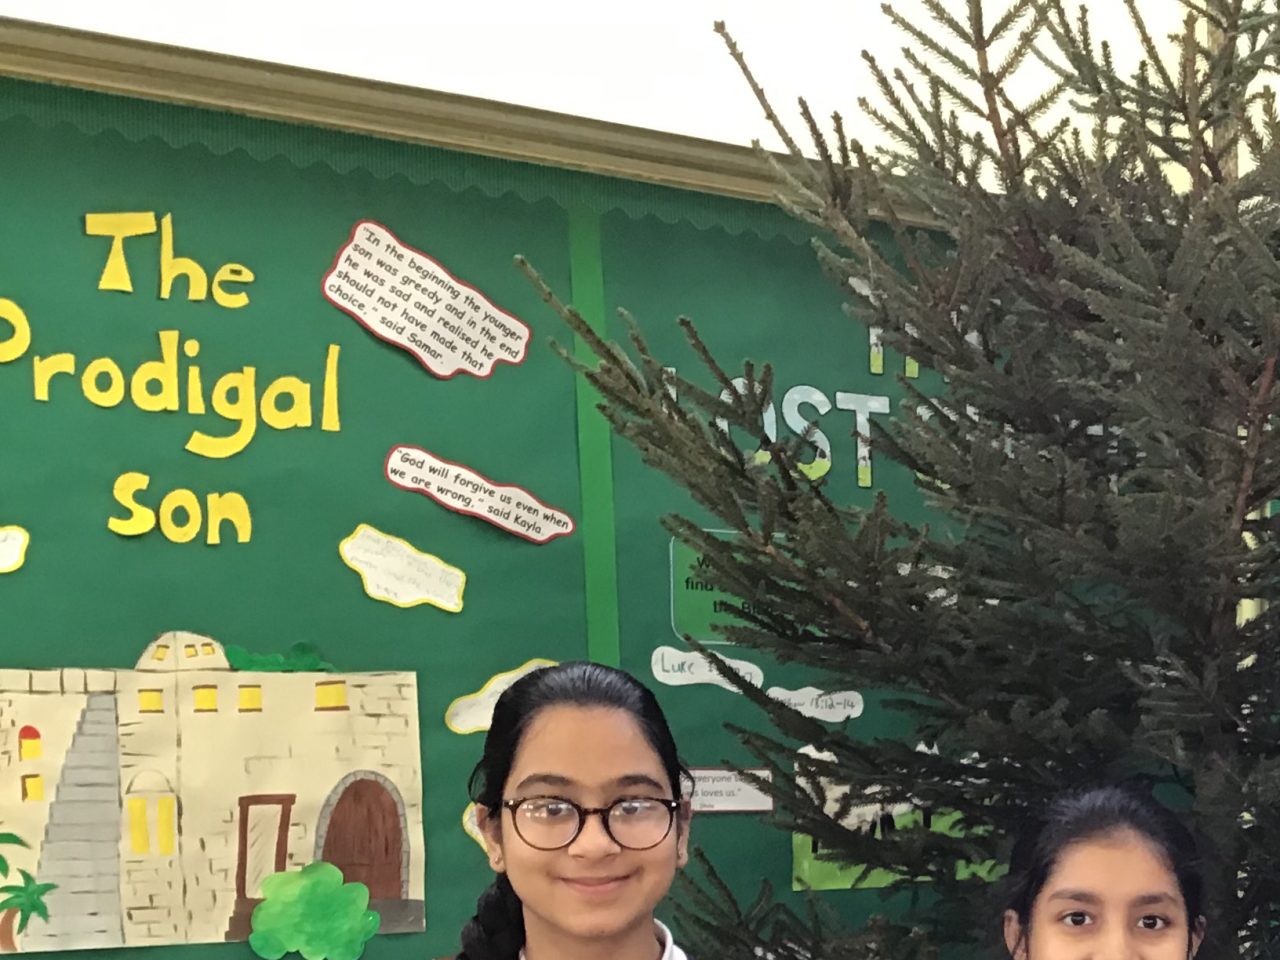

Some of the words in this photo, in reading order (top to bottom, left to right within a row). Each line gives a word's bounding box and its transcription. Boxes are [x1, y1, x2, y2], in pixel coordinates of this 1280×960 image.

[85, 212, 255, 308] The
[344, 255, 359, 270] he
[363, 268, 385, 287] was
[389, 284, 411, 302] sad
[414, 301, 435, 318] and
[438, 316, 479, 349] realised
[481, 345, 495, 360] he
[352, 243, 372, 260] son
[376, 258, 398, 277] was
[400, 275, 442, 305] greedy
[445, 302, 465, 320] and
[467, 315, 476, 329] in
[480, 327, 496, 343] the
[499, 342, 519, 359] end
[385, 243, 404, 262] the
[408, 259, 460, 300] beginning
[464, 295, 480, 313] the
[483, 311, 522, 342] younger
[336, 269, 375, 297] should
[377, 296, 398, 312] not
[400, 310, 427, 332] have
[430, 331, 458, 353] made
[461, 351, 485, 371] that
[379, 314, 405, 335] said
[407, 333, 444, 365] Samar.
[107, 472, 252, 545] Son
[390, 466, 406, 479] we
[410, 476, 432, 489] are
[487, 504, 511, 520] said
[513, 512, 544, 537] Kayla.
[428, 464, 449, 480] will
[452, 473, 496, 497] forgive
[500, 493, 512, 504] us
[515, 501, 539, 517] even
[542, 512, 569, 530] when
